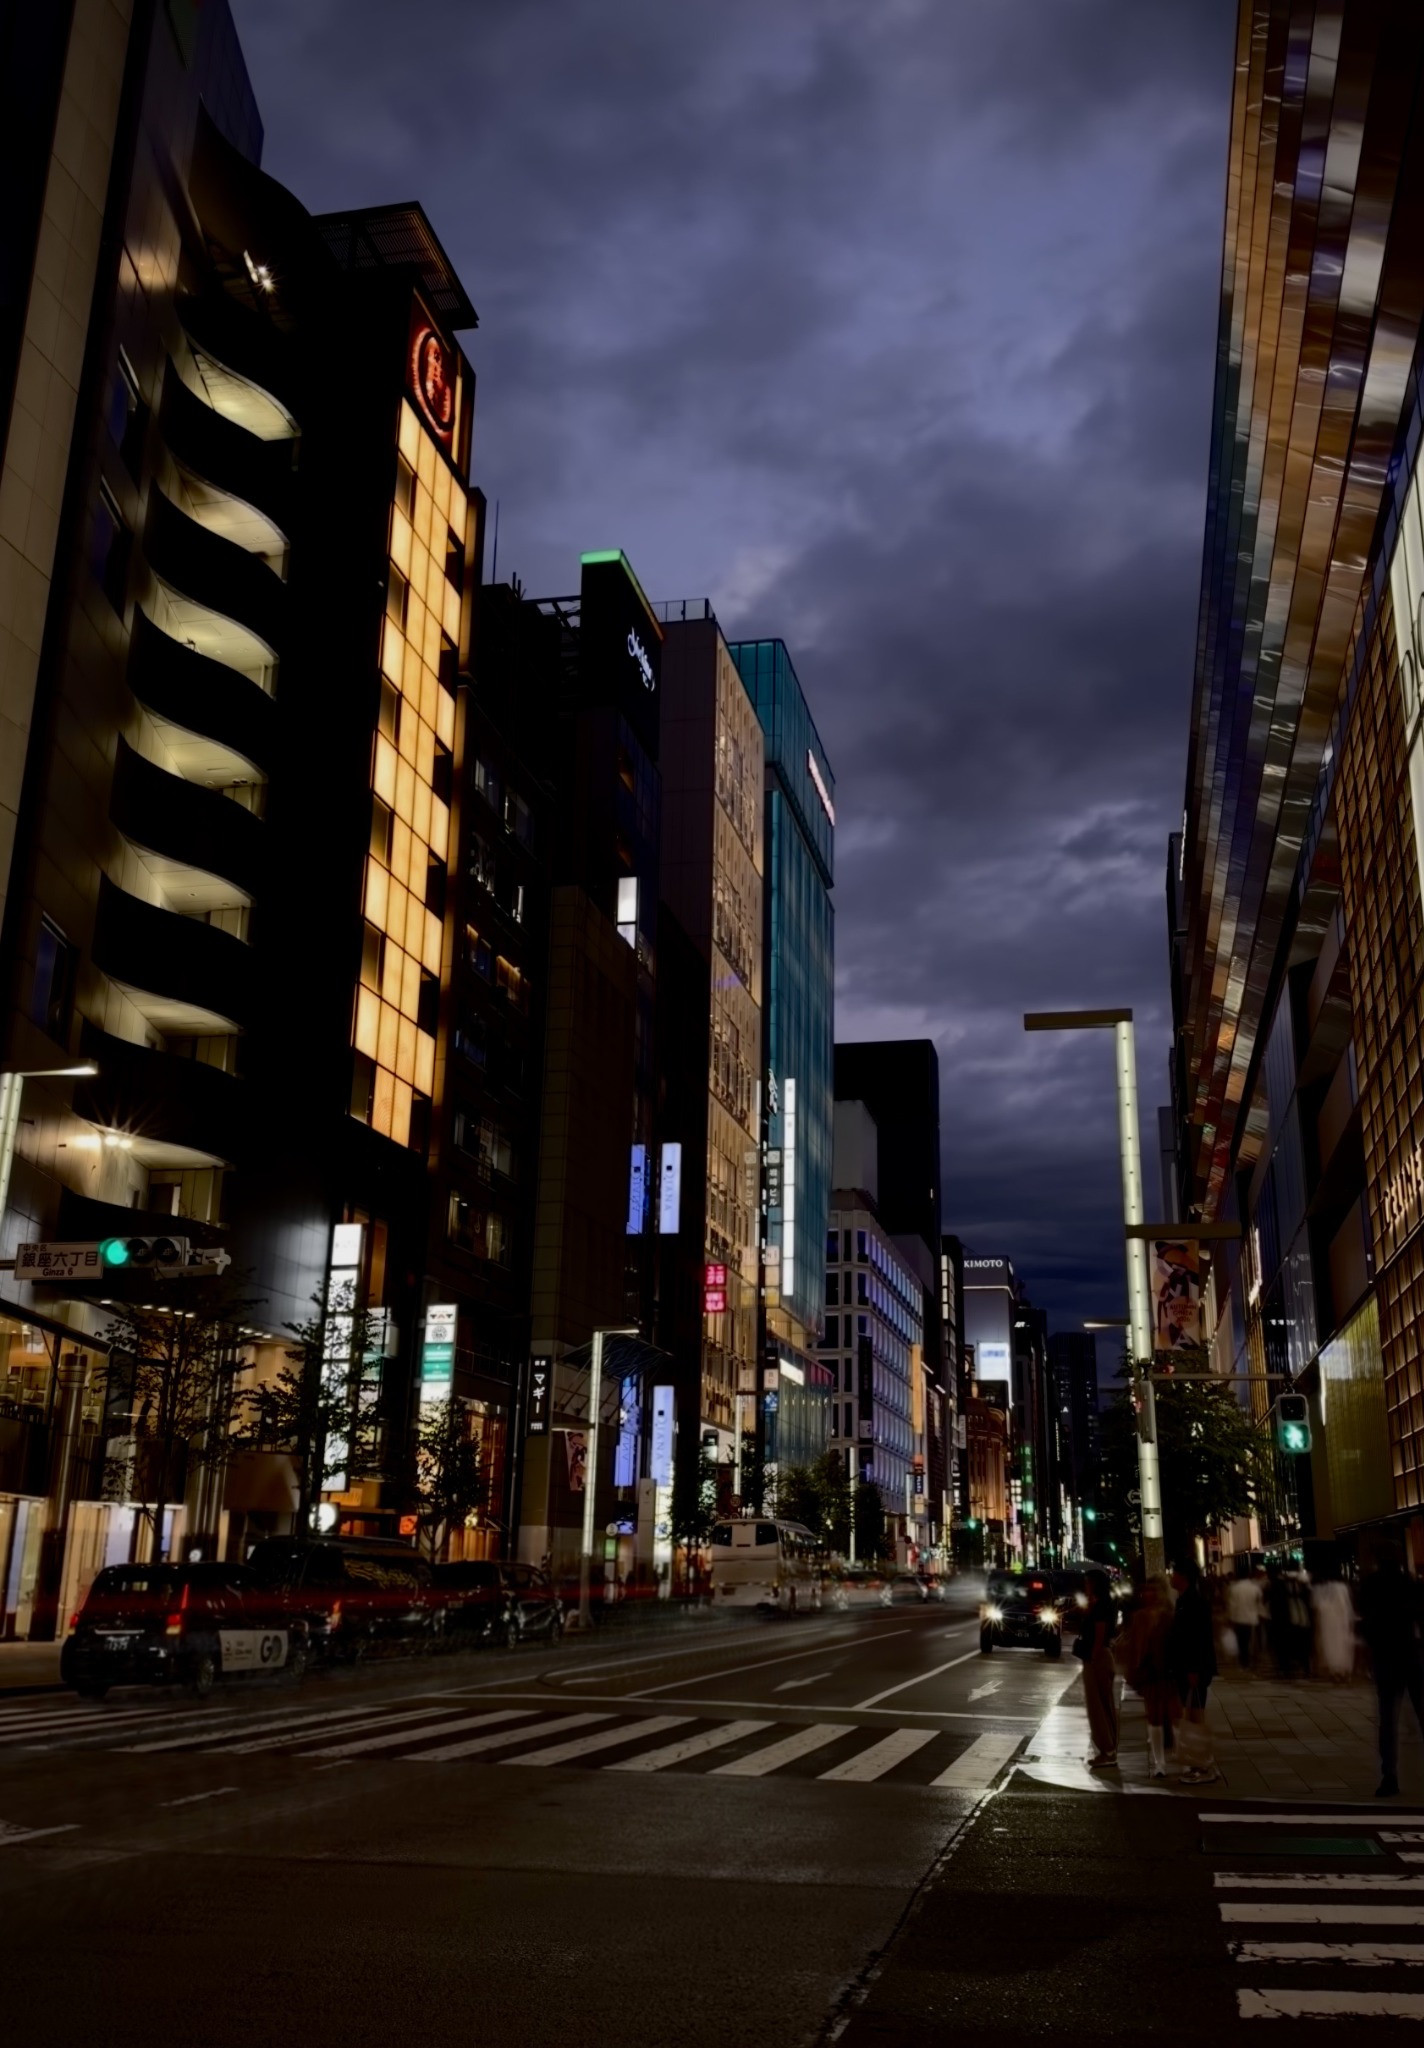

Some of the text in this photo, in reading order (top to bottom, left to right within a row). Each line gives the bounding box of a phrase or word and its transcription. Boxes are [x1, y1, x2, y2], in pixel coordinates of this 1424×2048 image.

[23, 1244, 47, 1252] 中央区
[22, 1251, 98, 1267] 銀座六丁目
[42, 1267, 73, 1277] Ginza 6
[532, 1373, 546, 1414] マギー
